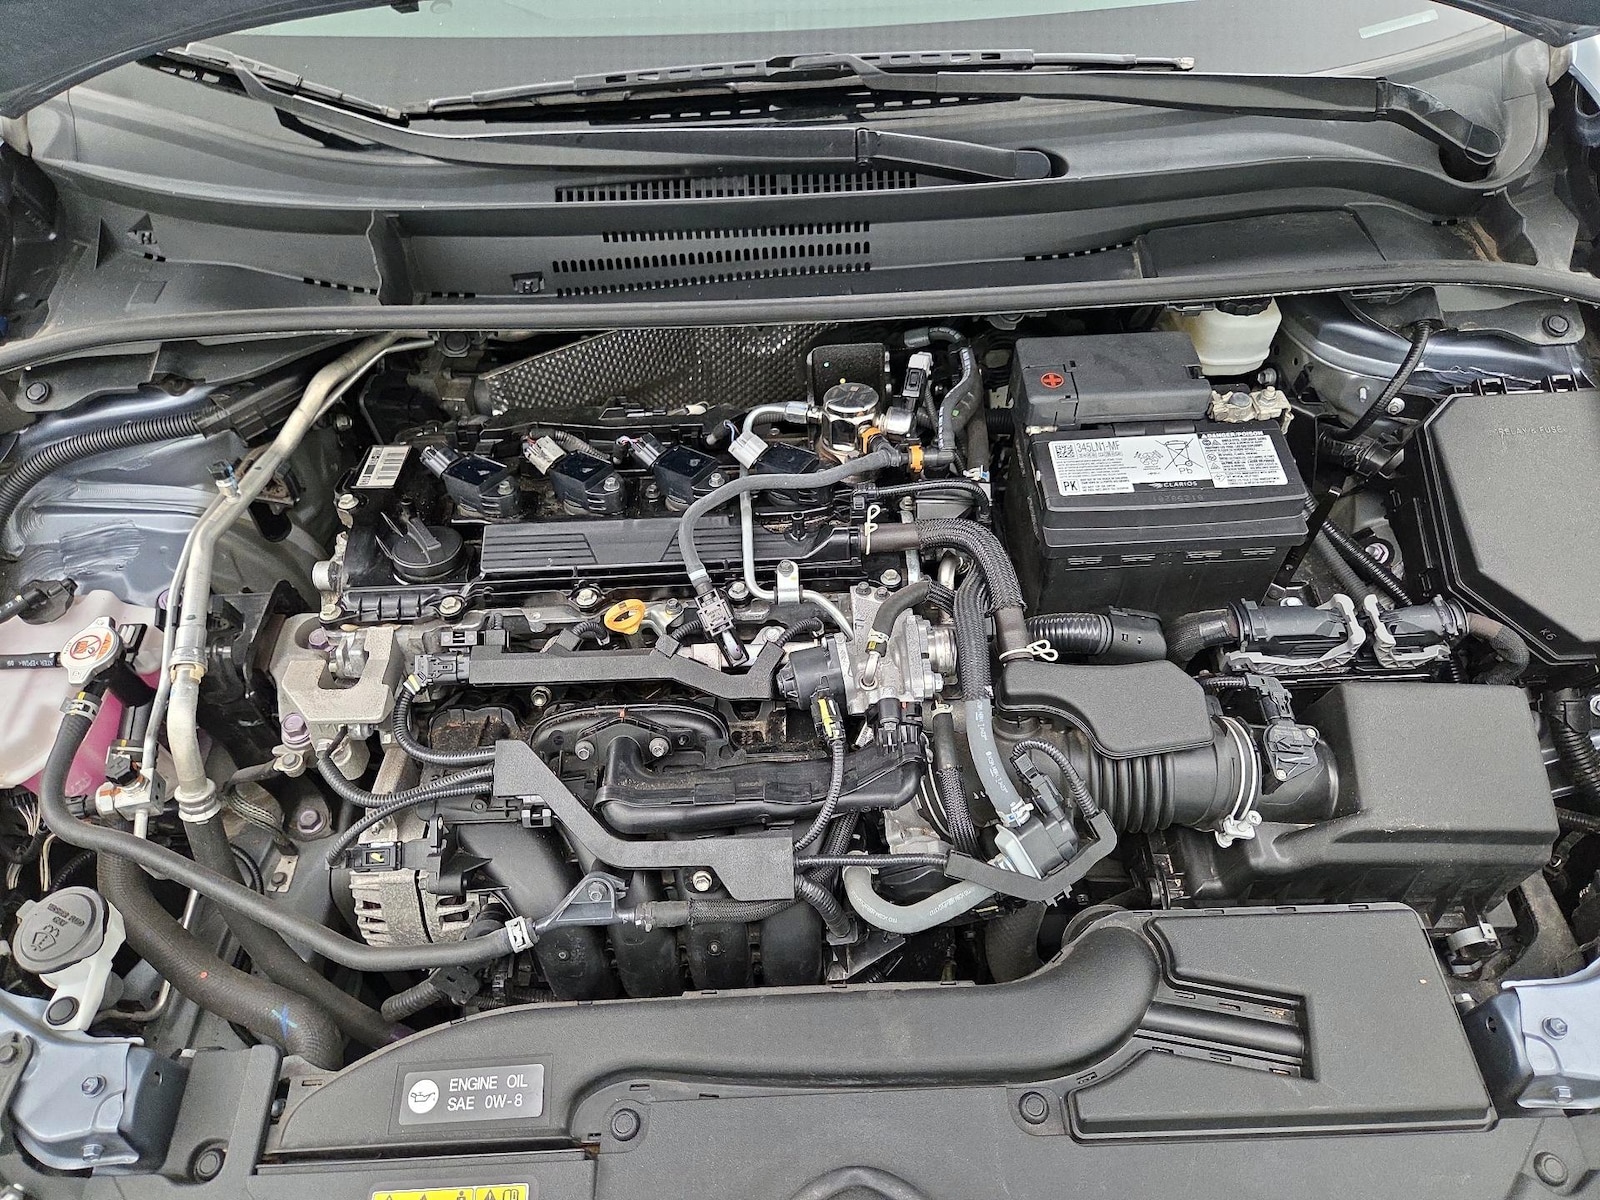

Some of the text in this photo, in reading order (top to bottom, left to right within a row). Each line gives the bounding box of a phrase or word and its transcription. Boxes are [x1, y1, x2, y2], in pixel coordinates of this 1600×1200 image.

[1063, 480, 1079, 492] PK
[1163, 480, 1198, 488] CLARIOS
[449, 1074, 528, 1092] ENGINE OIL
[447, 1093, 524, 1111] SAE 0W-8
